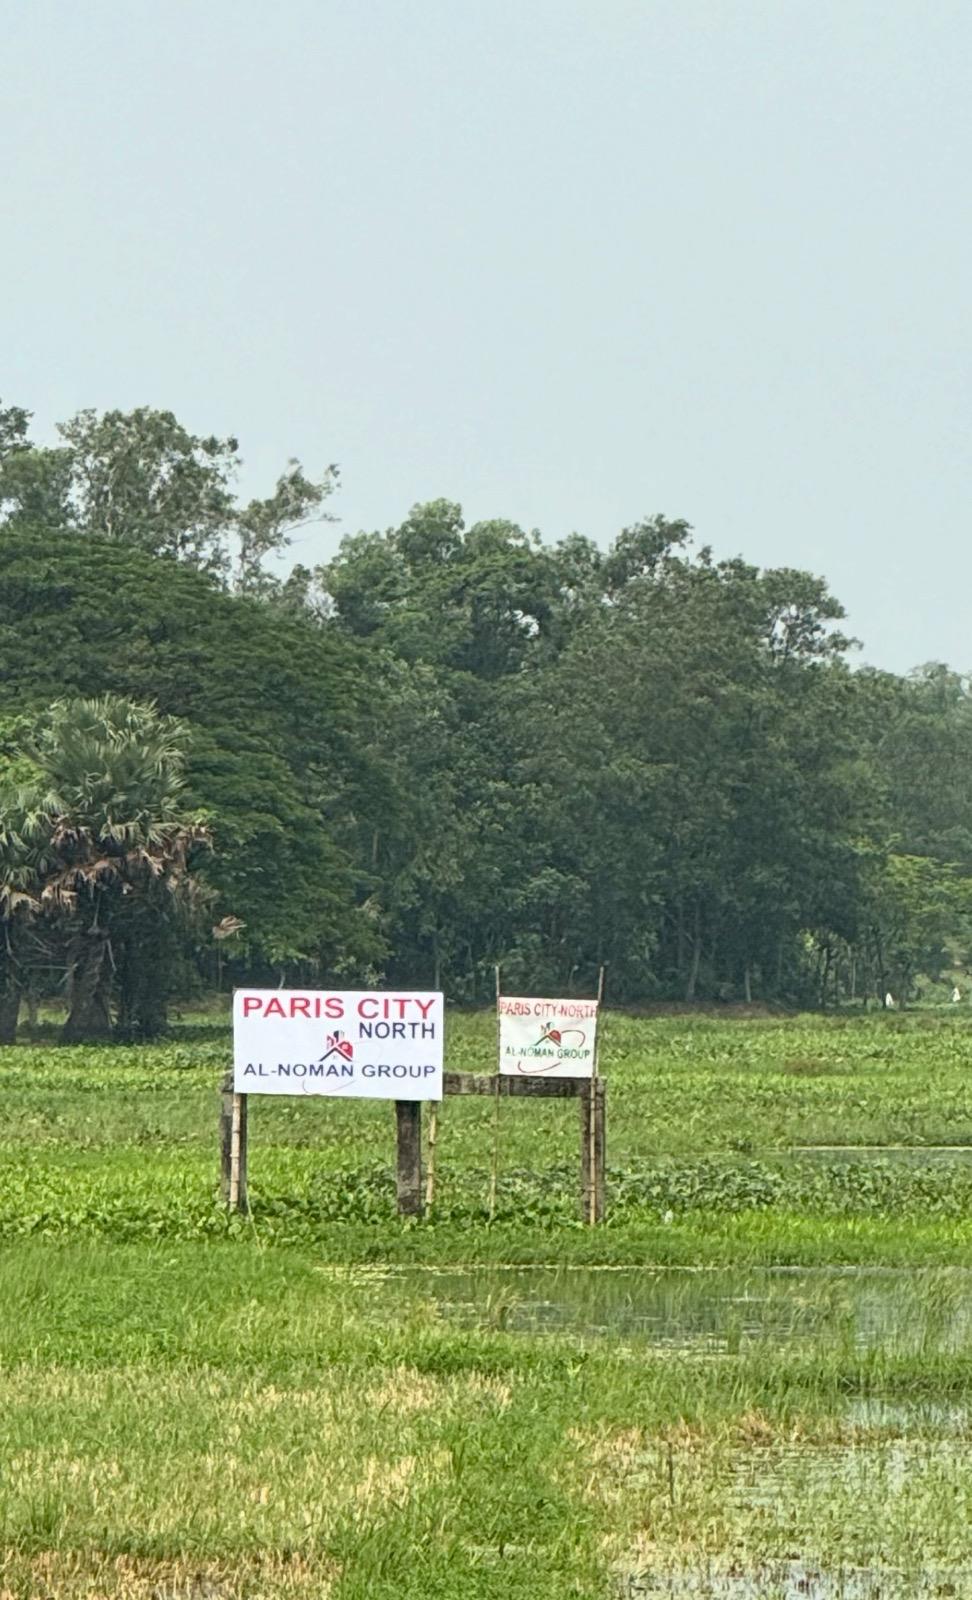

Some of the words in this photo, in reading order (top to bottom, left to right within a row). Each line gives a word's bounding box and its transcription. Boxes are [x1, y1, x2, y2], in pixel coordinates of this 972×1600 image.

[243, 997, 345, 1019] PARIS
[357, 998, 435, 1019] CITY
[500, 1002, 531, 1016] PARIS
[359, 1022, 435, 1039] NORTH
[557, 1048, 591, 1059] GROUP
[243, 1063, 354, 1077] AL-NOMAN
[361, 1064, 436, 1078] GROUP
